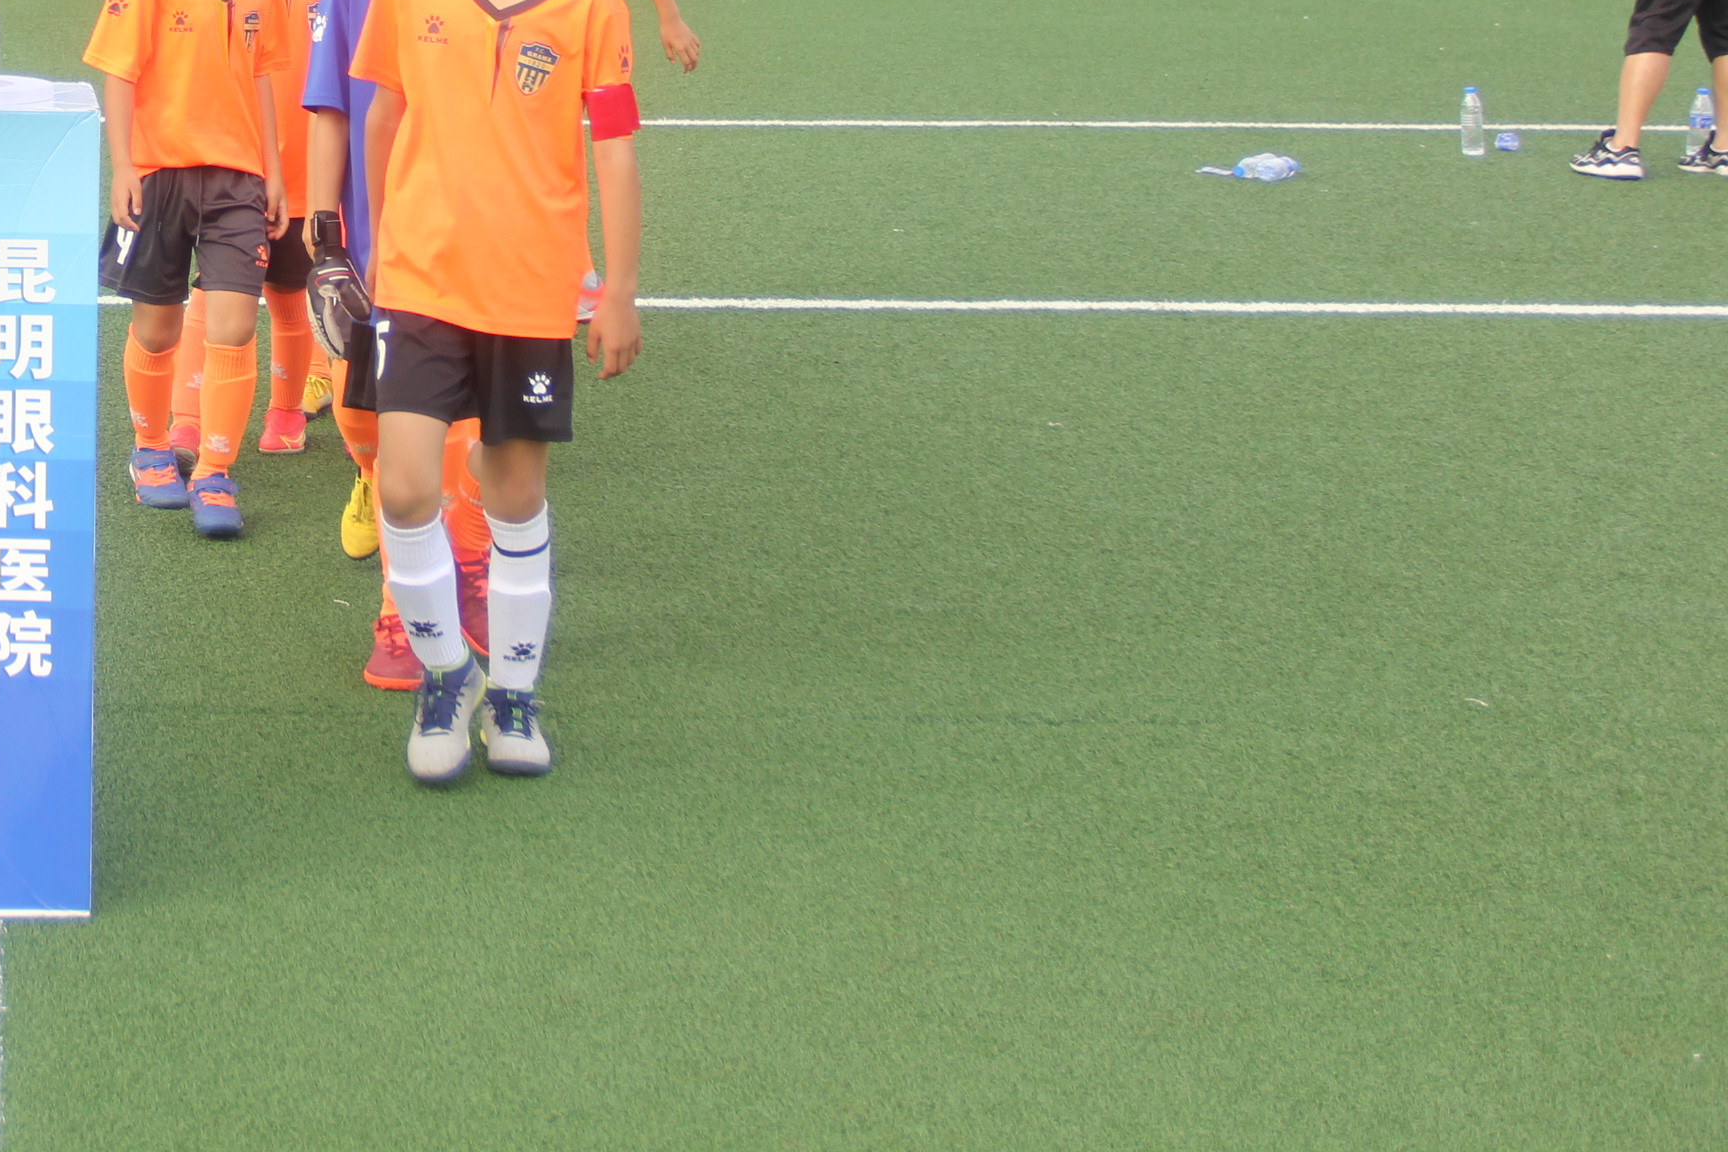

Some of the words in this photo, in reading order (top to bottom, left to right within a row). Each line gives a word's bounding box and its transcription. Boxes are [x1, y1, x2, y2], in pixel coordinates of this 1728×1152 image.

[417, 35, 449, 45] KELME
[522, 394, 554, 404] KELME
[409, 630, 444, 639] KELME
[502, 653, 537, 663] KELME
